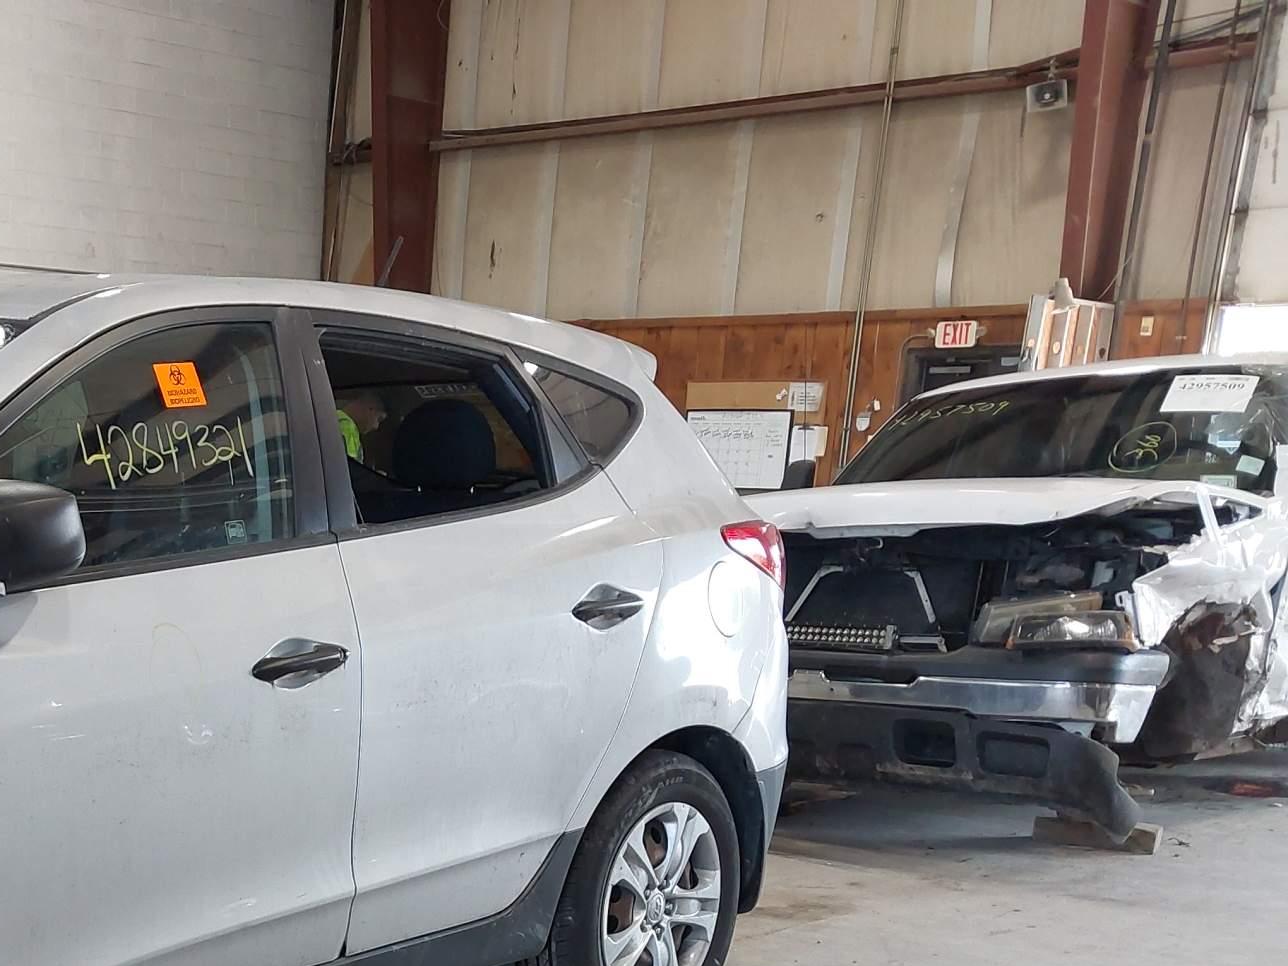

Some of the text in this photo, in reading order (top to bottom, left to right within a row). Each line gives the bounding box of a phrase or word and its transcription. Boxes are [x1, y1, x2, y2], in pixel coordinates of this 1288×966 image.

[942, 322, 972, 345] EXIT
[1178, 382, 1246, 391] 42957509
[76, 415, 254, 489] 42849321
